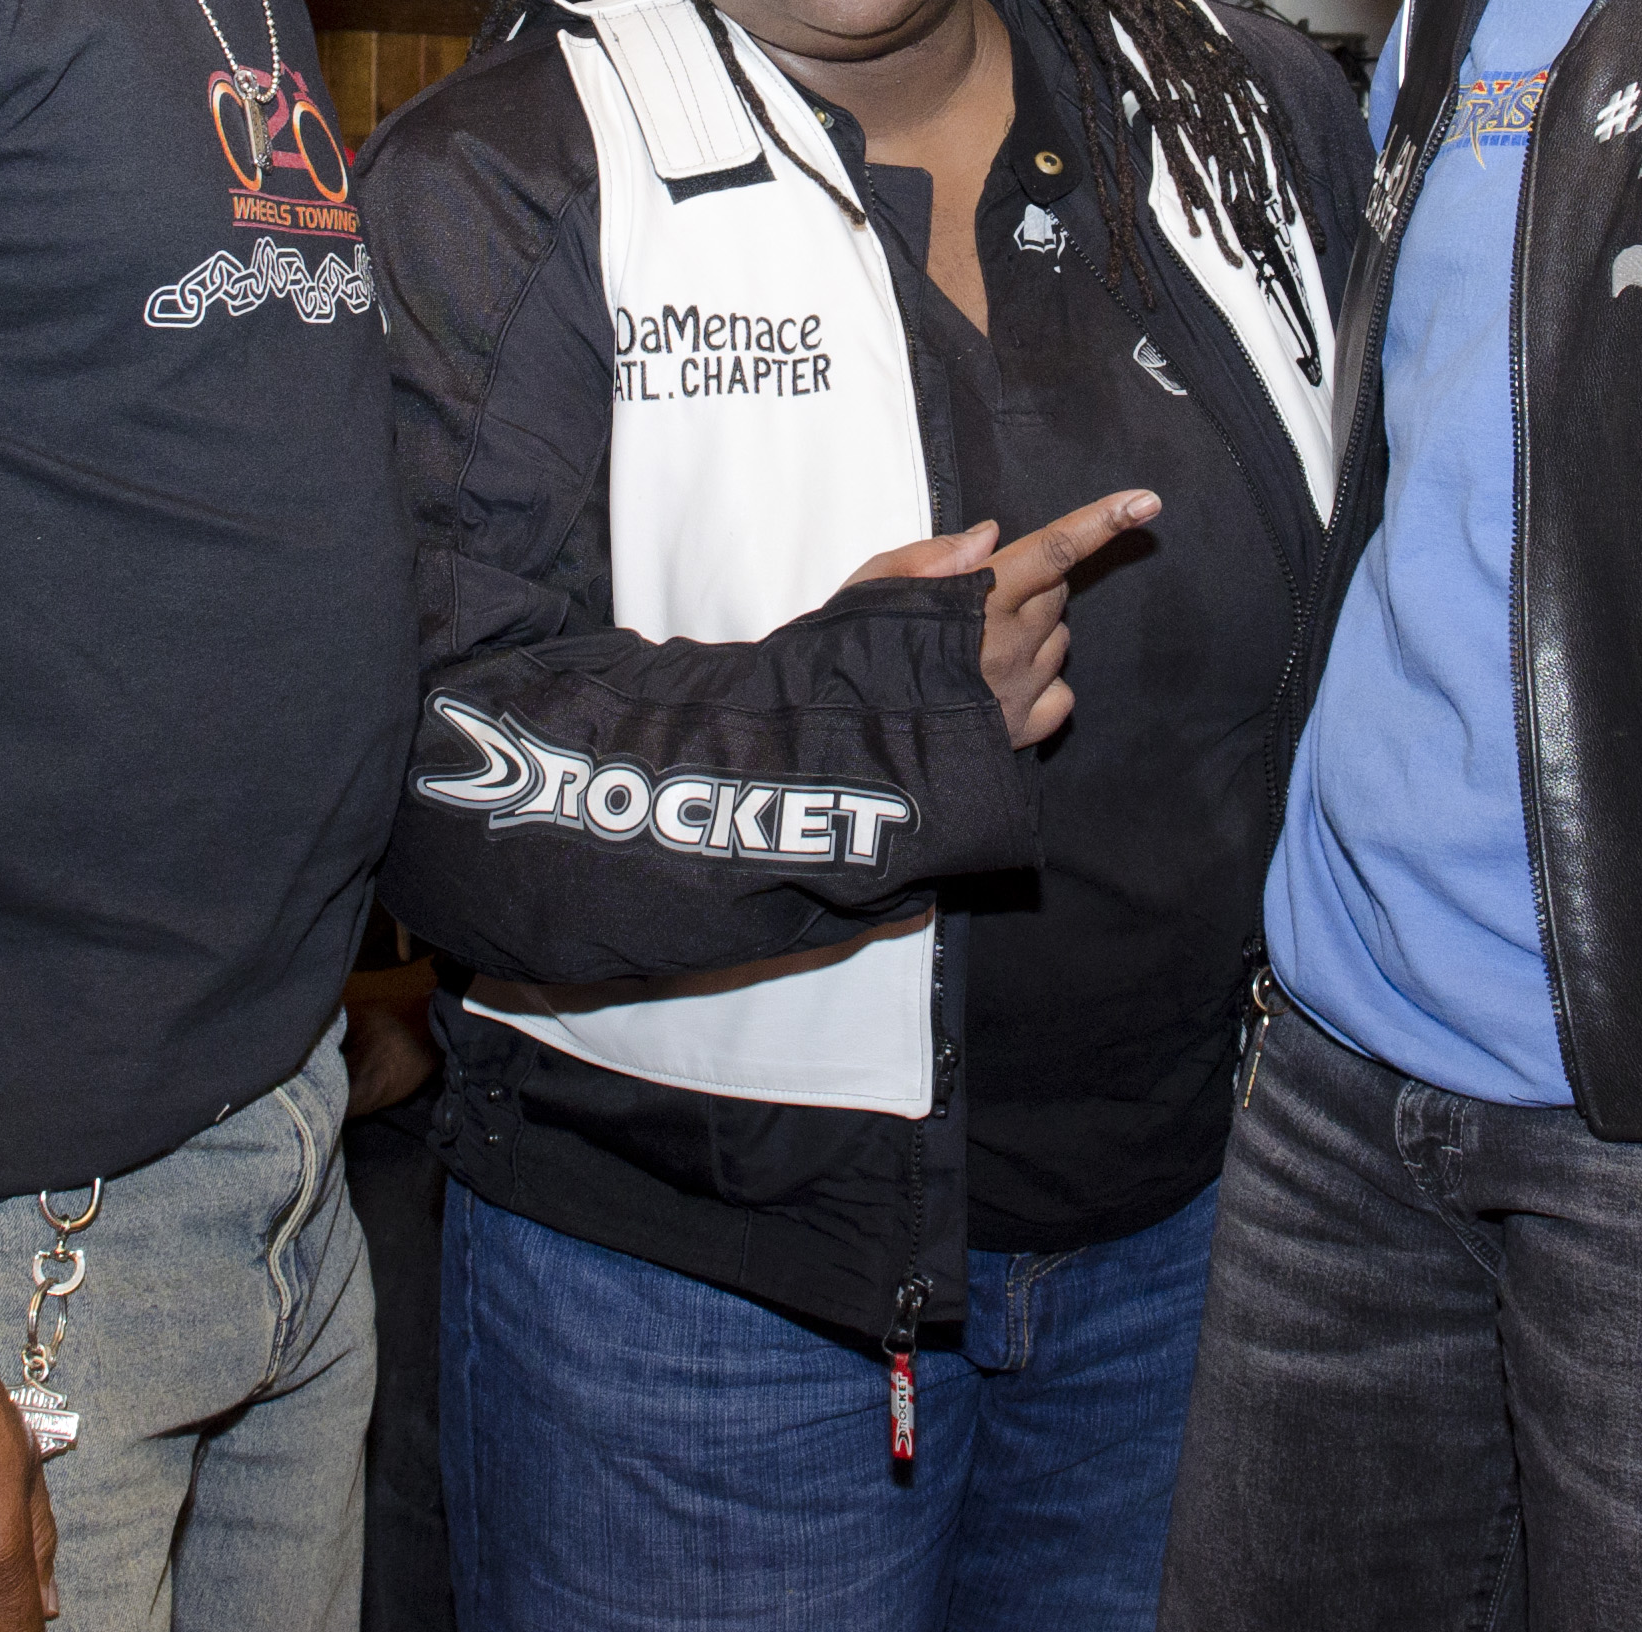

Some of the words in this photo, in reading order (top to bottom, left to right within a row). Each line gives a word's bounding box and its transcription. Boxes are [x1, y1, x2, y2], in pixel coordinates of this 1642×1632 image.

[233, 196, 291, 226] WHEELS
[295, 206, 357, 233] TOWING
[616, 304, 823, 356] DaMenace
[681, 353, 832, 399] CHAPTER
[502, 730, 909, 863] ROCKET
